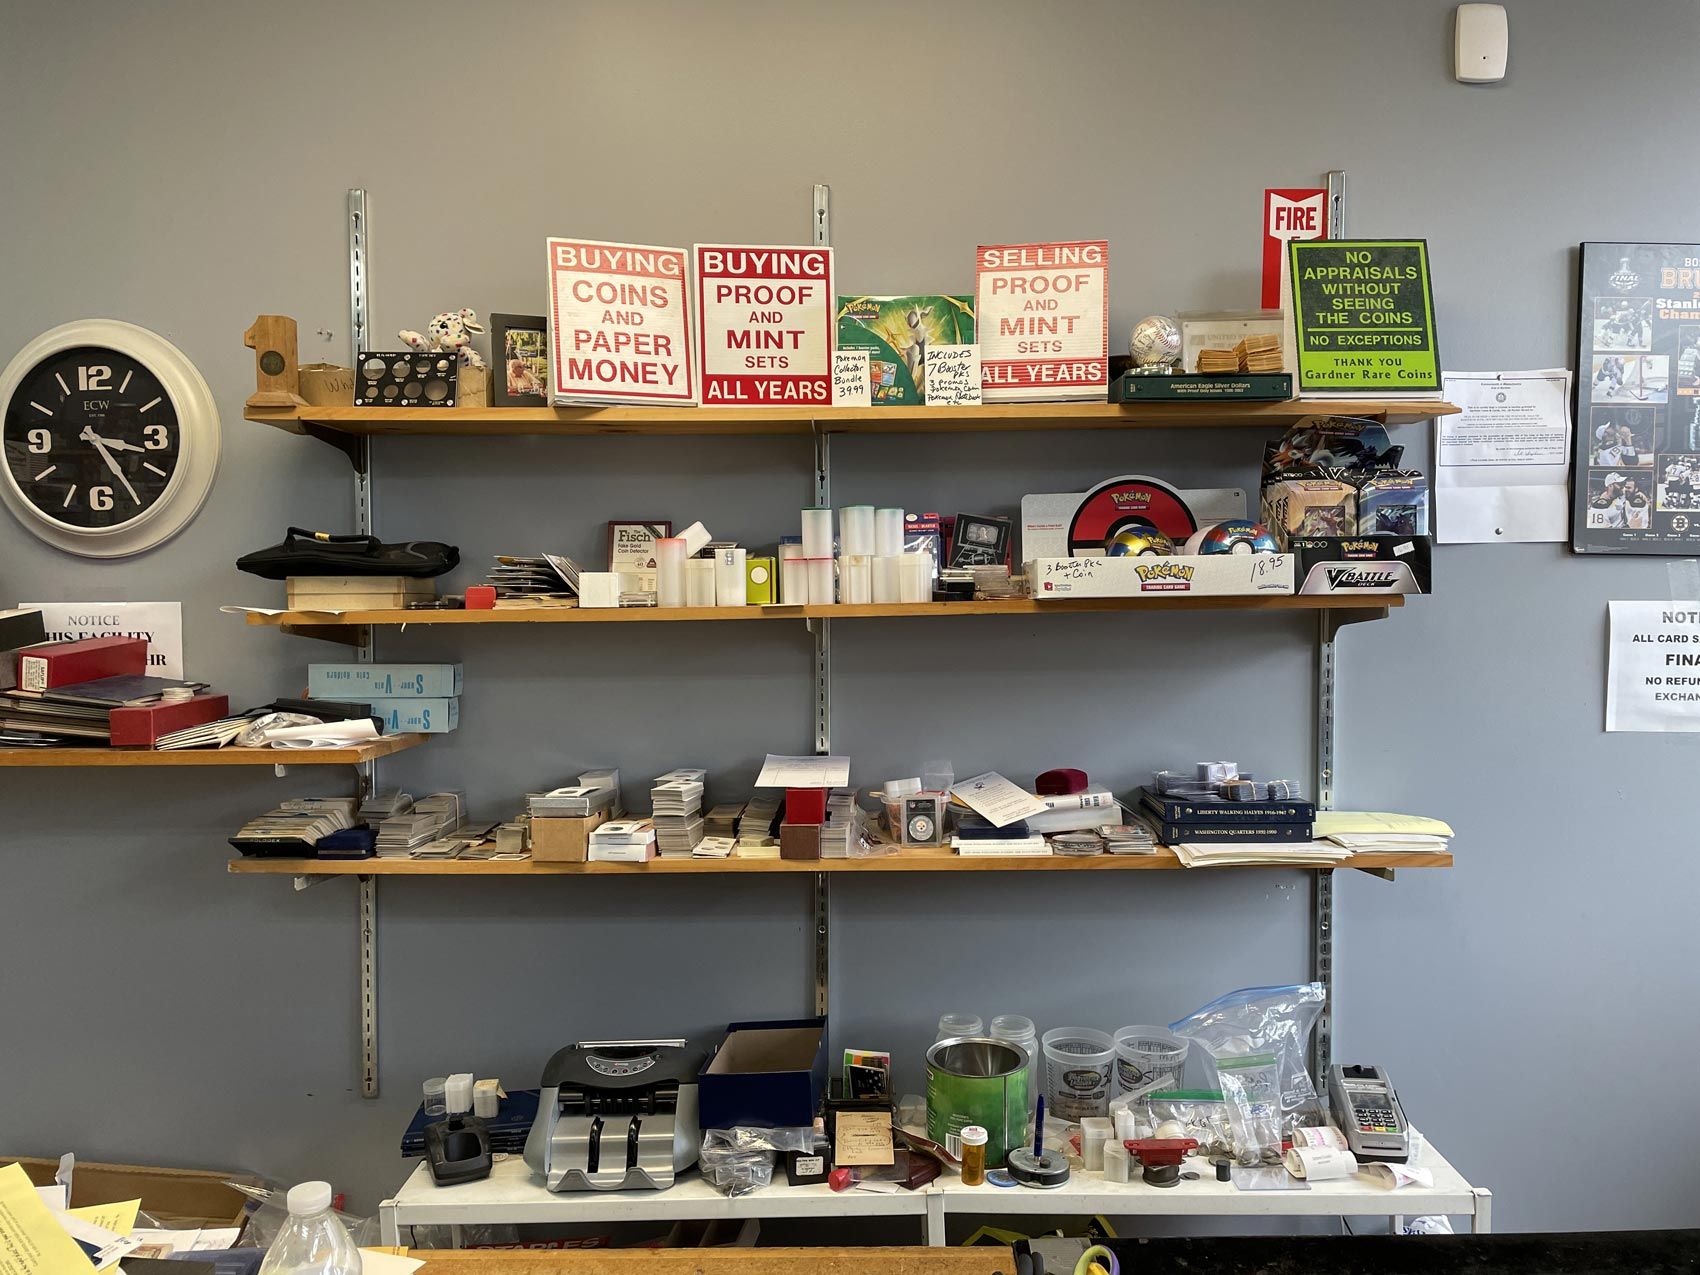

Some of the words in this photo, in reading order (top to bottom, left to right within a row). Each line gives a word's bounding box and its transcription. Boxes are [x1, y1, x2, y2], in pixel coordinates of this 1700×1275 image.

[1275, 207, 1317, 230] FIRE
[556, 246, 681, 276] BUYING
[704, 251, 825, 275] BUYING
[983, 246, 1102, 268] SELLING
[1346, 251, 1372, 264] NO
[1304, 267, 1418, 280] APPRAISALS
[992, 274, 1090, 295] PROOF
[1322, 283, 1401, 296] WITHOUT
[572, 280, 669, 308] COINS
[716, 285, 814, 305] PROOF
[1024, 299, 1058, 311] AND
[1332, 298, 1395, 310] SEEING
[601, 310, 644, 326] AND
[749, 311, 783, 324] AND
[1316, 312, 1349, 324] THE
[1358, 312, 1413, 324] COINS
[1000, 316, 1080, 336] MINT
[574, 329, 672, 357] PAPER
[726, 330, 805, 350] MINT
[1310, 335, 1330, 346] NO
[1338, 335, 1422, 346] EXCEPTIONS
[1017, 340, 1063, 354] SETS
[745, 355, 789, 369] SETS
[1334, 358, 1373, 367] THANK
[1379, 358, 1402, 366] YOU
[569, 358, 679, 386] MONEY
[928, 364, 936, 376] 7
[982, 366, 1024, 384] ALL
[1028, 362, 1102, 382] YEARS
[1305, 370, 1356, 380] Gardner
[1362, 370, 1391, 380] Rare
[1397, 370, 1432, 380] Coins
[78, 366, 112, 391] 12
[834, 376, 862, 385] Bundle
[708, 381, 748, 400] ALL
[754, 380, 828, 400] YEARS
[840, 384, 864, 398] 39.99
[84, 400, 110, 411] ECW
[28, 428, 52, 454] 9
[144, 424, 168, 450] 3
[90, 486, 114, 511] 6
[1592, 514, 1604, 524] 18
[618, 530, 651, 542] Fisch
[1046, 564, 1052, 575] 3
[1072, 569, 1094, 579] Coin
[1250, 555, 1285, 582] 18.95
[1346, 572, 1394, 582] BATTLE
[68, 616, 120, 626] NOTICE
[45, 632, 72, 642] HIS
[1658, 634, 1688, 643] CARD
[1645, 677, 1662, 685] NO
